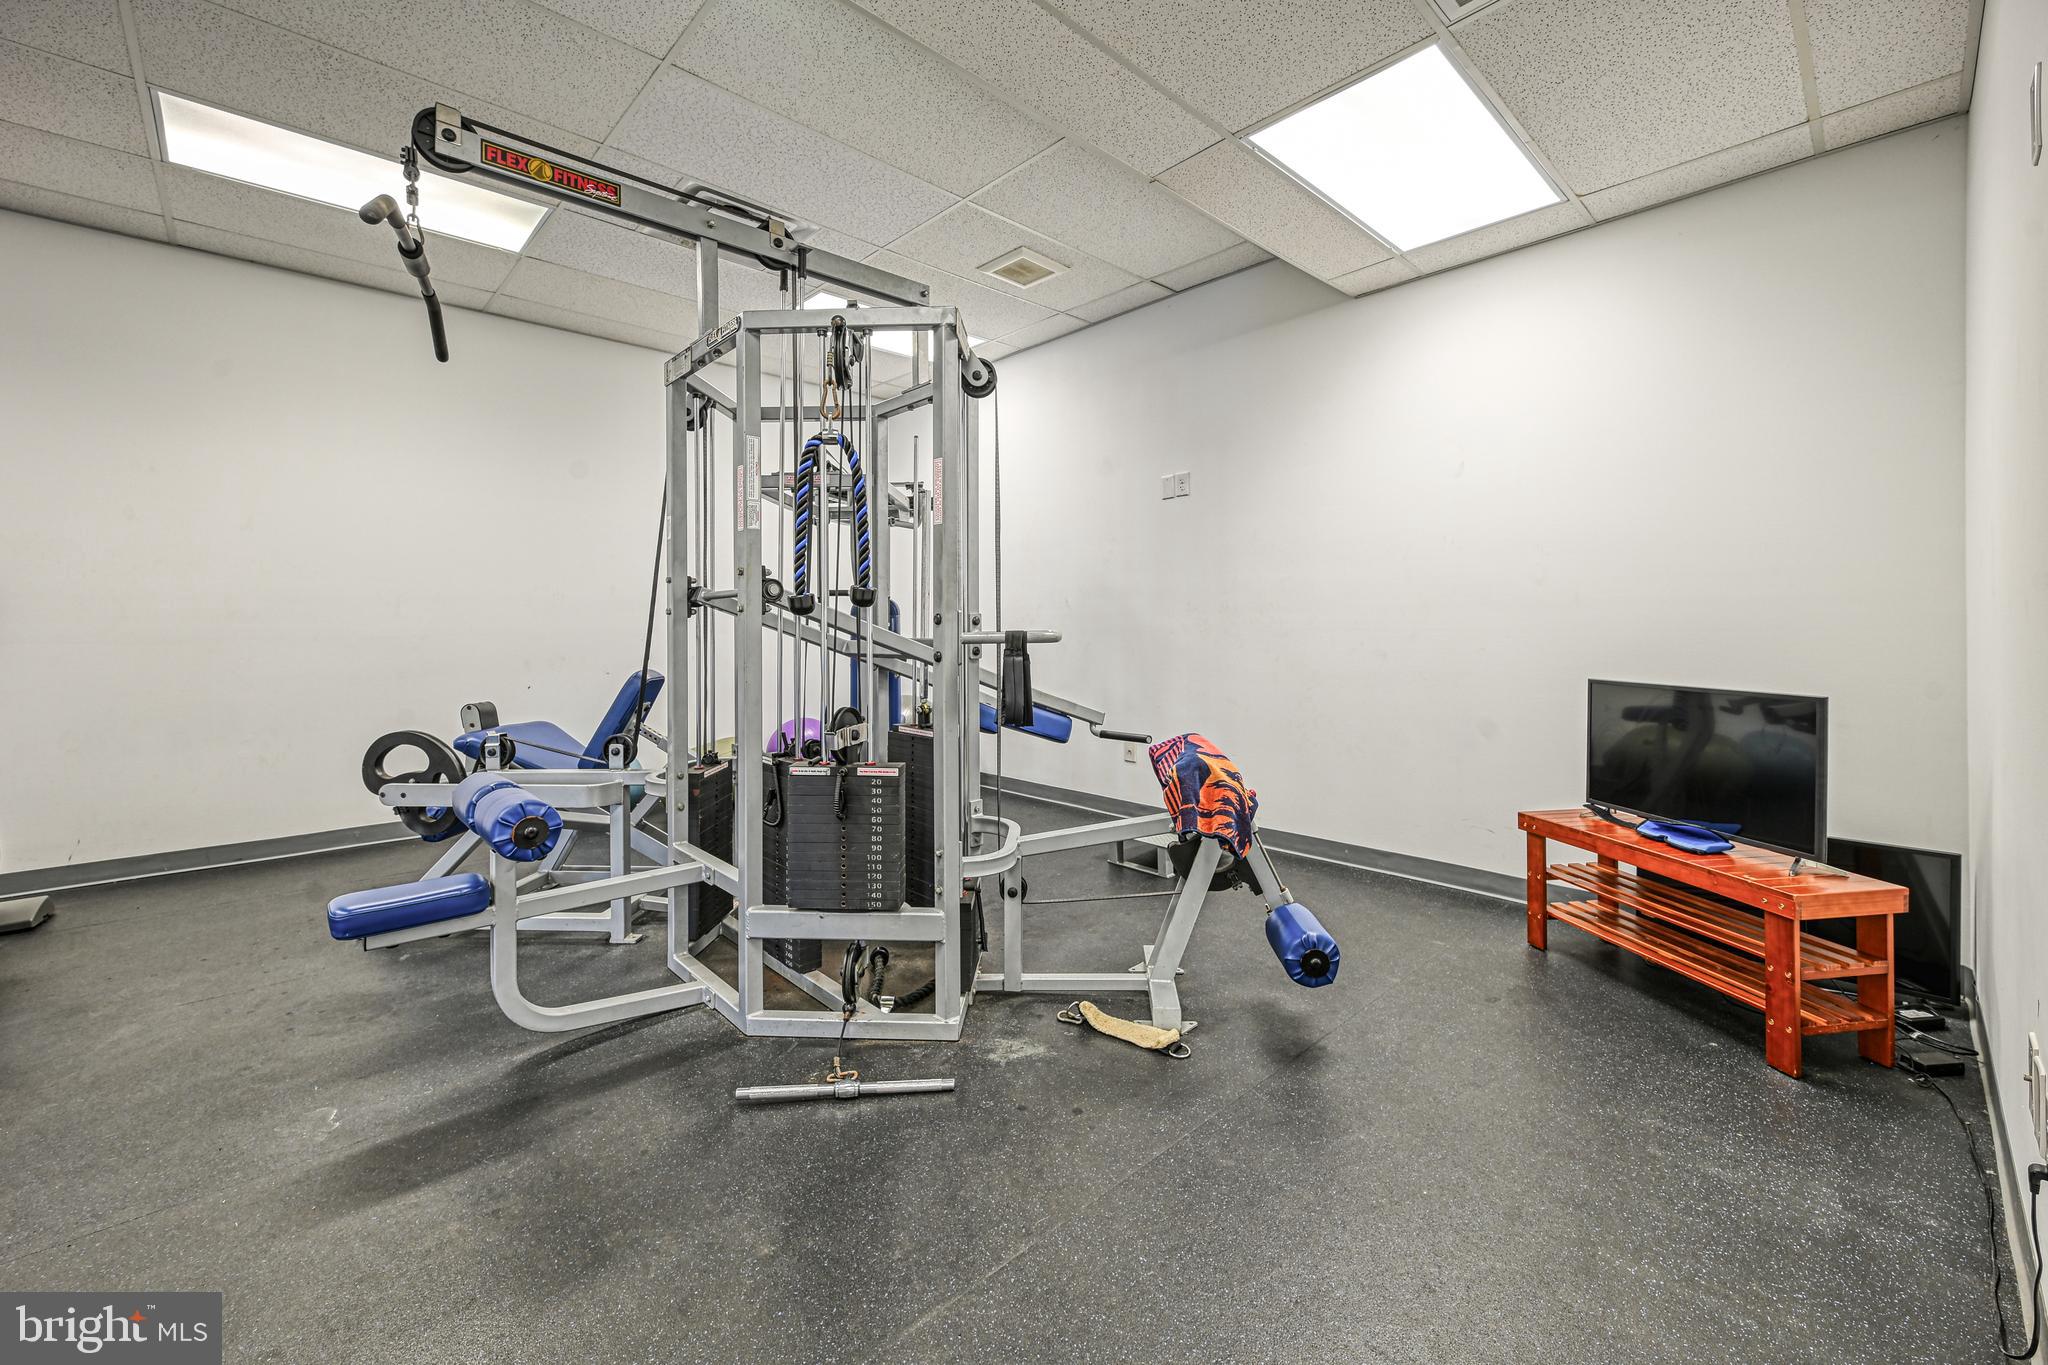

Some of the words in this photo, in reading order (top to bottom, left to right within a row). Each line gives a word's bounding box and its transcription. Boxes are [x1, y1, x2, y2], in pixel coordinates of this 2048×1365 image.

[486, 145, 529, 172] FLEX
[553, 167, 617, 197] FITNESS
[871, 787, 882, 795] 30
[871, 796, 882, 804] 40
[871, 806, 882, 814] 50
[871, 815, 882, 823] 60
[871, 824, 882, 833] 70
[871, 834, 882, 842] 80
[871, 844, 882, 852] 90
[866, 872, 882, 880] 120
[866, 891, 882, 899] 140
